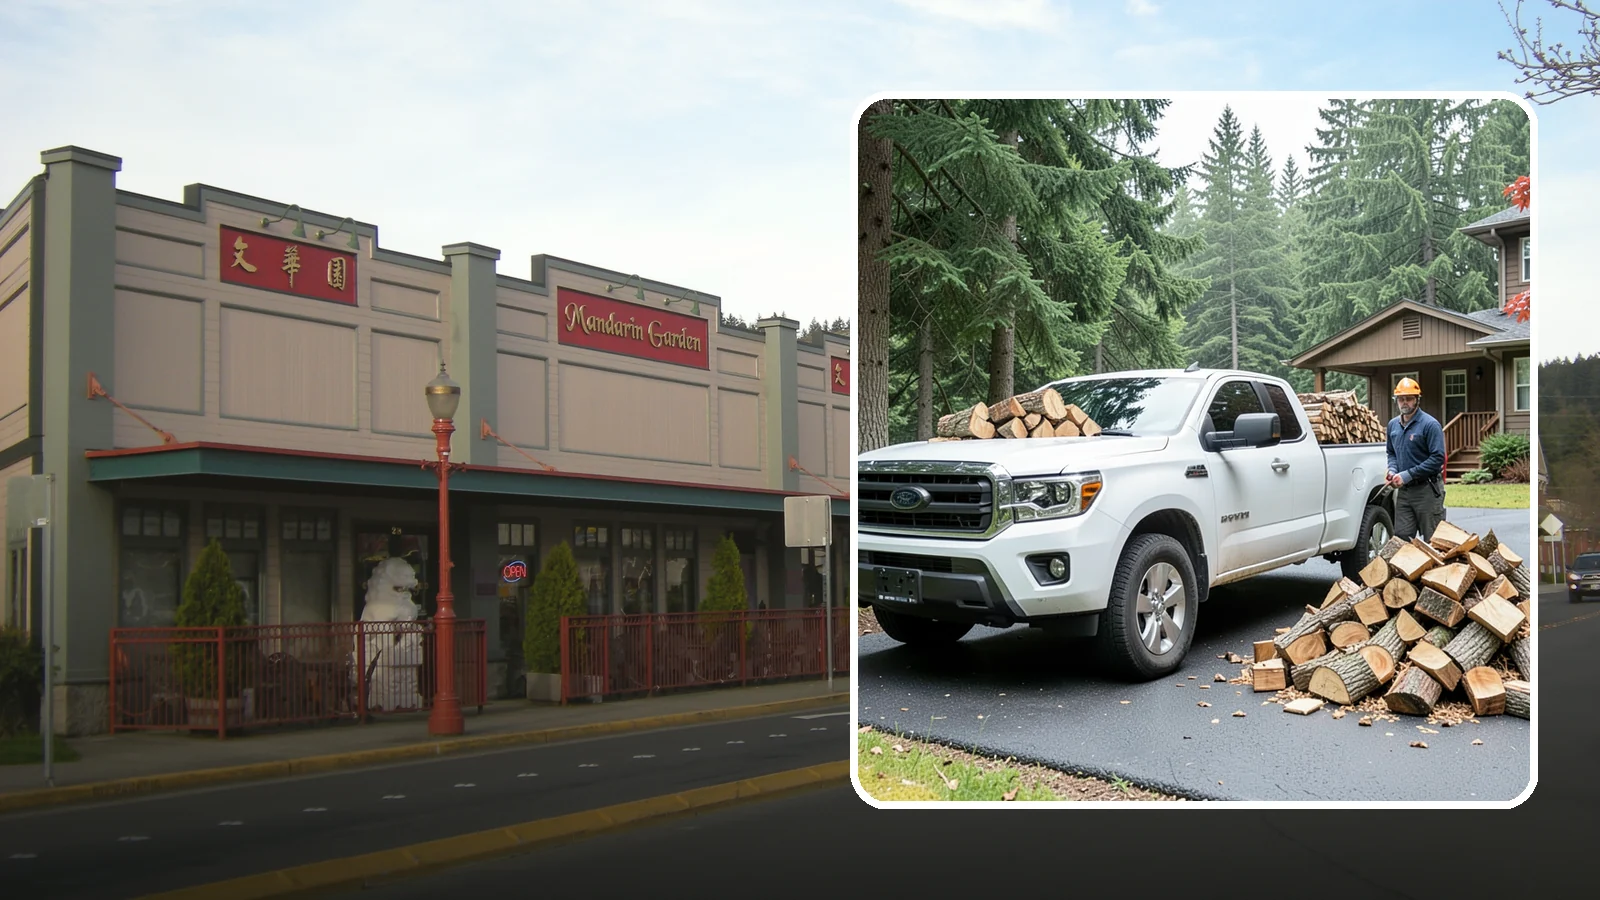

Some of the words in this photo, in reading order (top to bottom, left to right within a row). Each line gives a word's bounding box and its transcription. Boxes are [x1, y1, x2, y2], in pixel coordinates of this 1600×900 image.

[564, 302, 644, 341] Mandarin
[648, 320, 702, 352] Garden
[503, 565, 527, 578] OPEN
